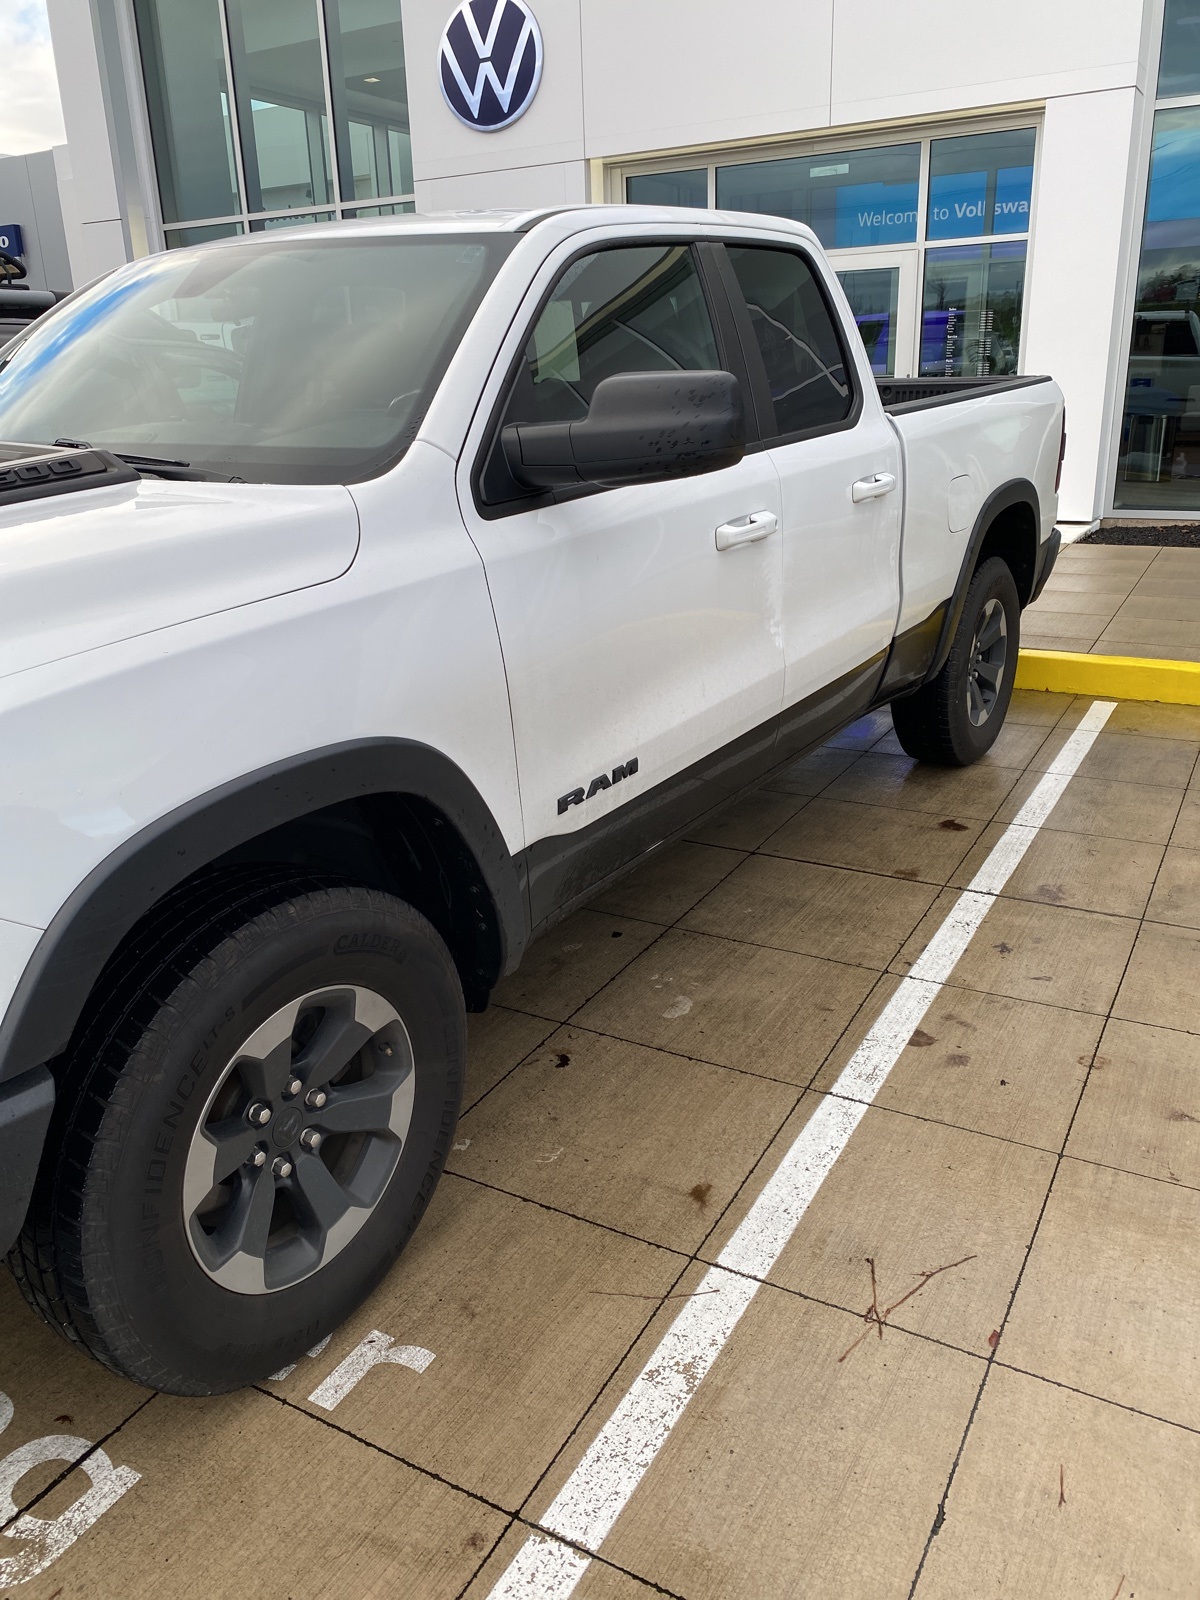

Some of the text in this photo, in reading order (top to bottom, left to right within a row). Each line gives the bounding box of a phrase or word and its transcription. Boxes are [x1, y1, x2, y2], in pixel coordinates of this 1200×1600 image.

[858, 201, 1029, 227] Welcom to Volswa
[557, 757, 639, 815] RAM
